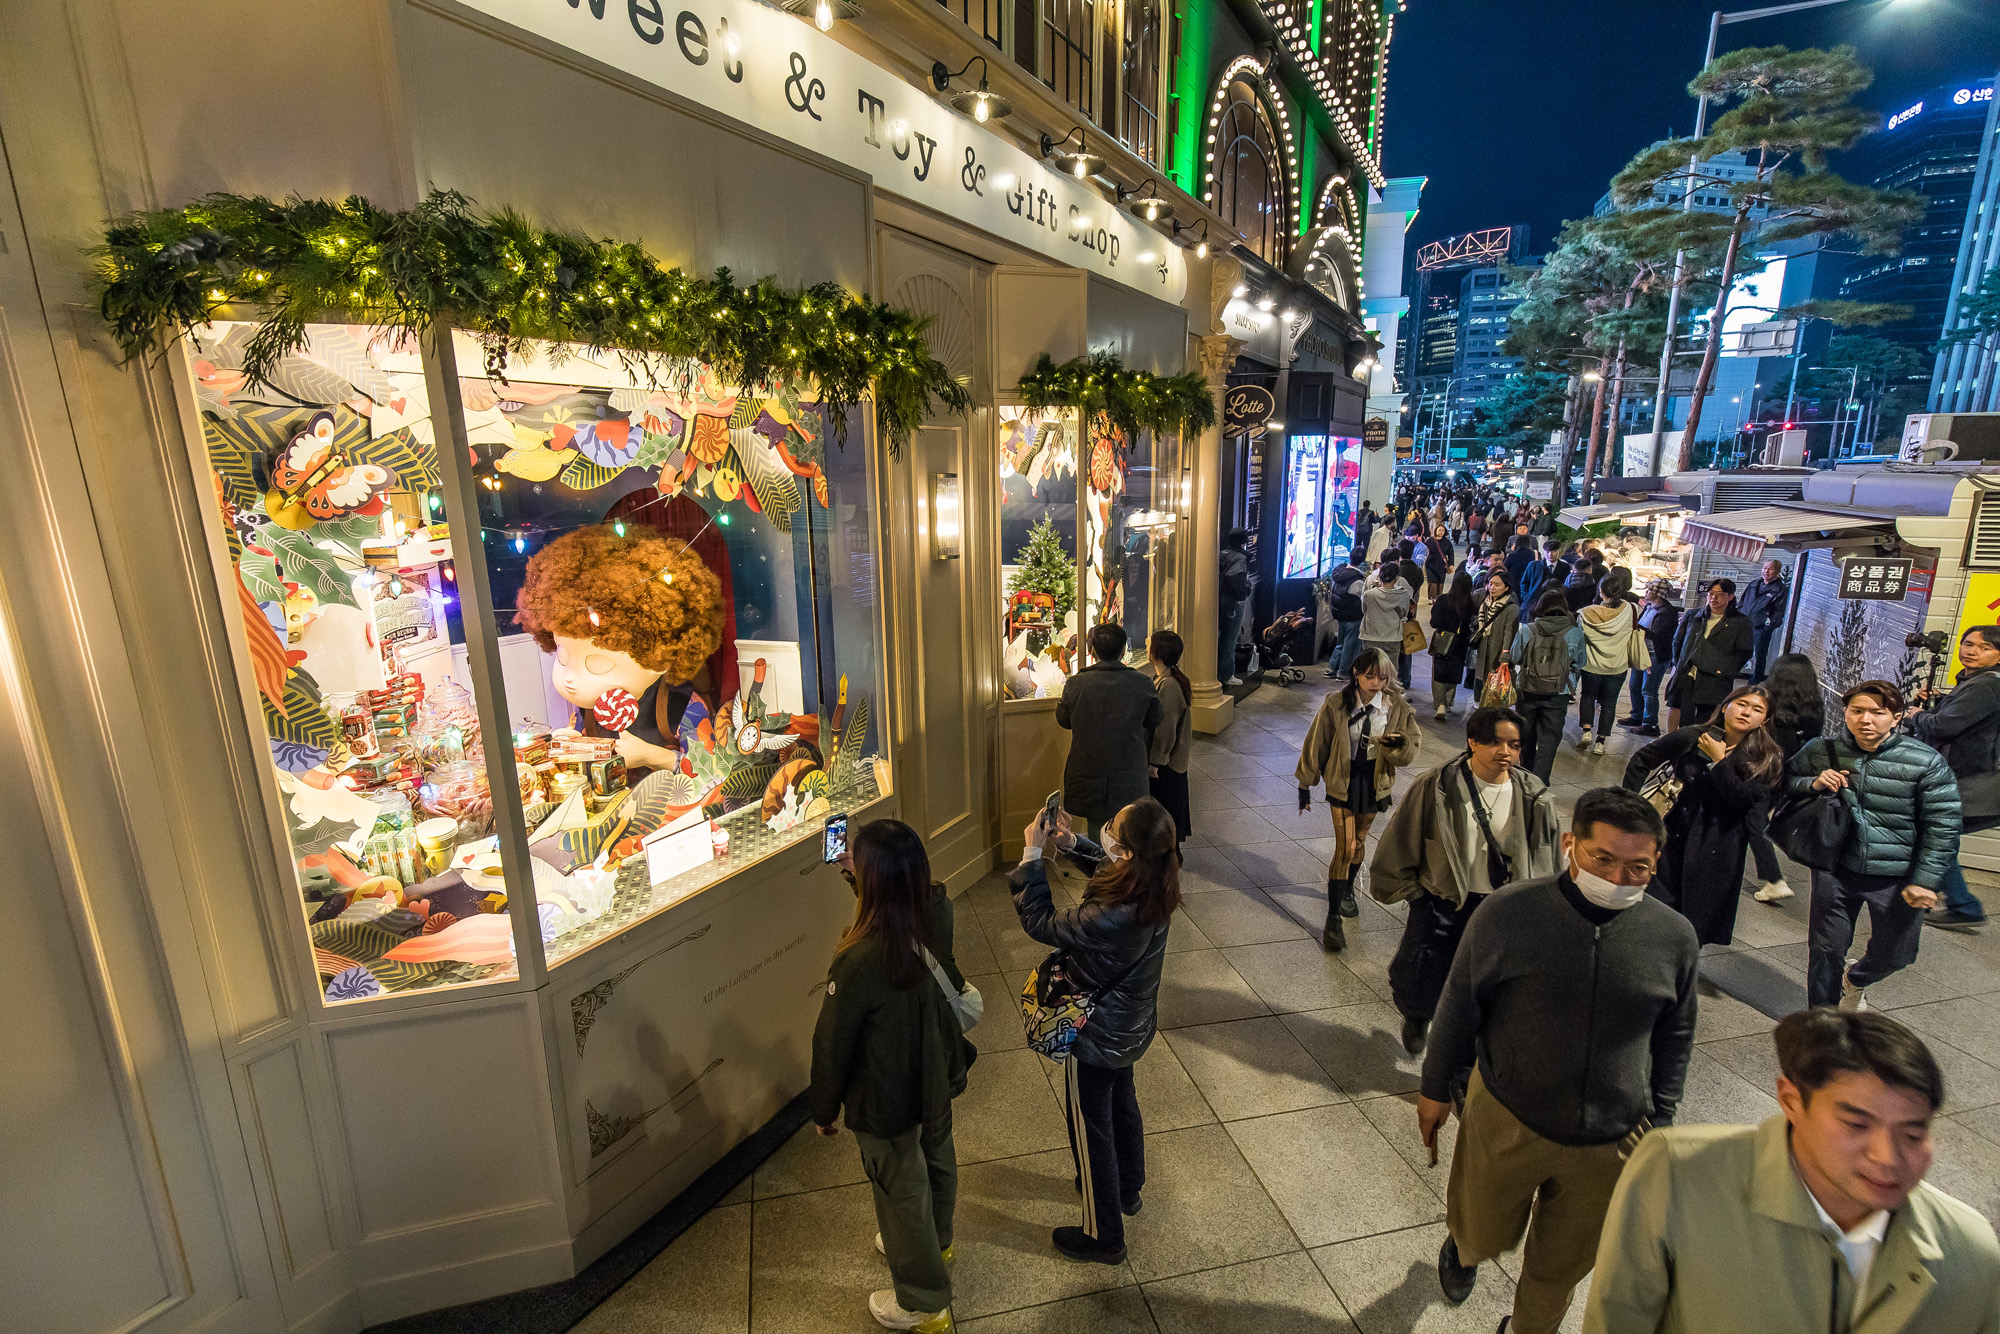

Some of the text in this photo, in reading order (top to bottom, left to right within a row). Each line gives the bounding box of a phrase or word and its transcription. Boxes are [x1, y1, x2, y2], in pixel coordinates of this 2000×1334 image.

[566, 0, 743, 83] eet
[785, 51, 825, 121] &
[858, 89, 937, 182] Toy
[961, 146, 986, 197] &
[1006, 172, 1058, 233] Gift
[1226, 393, 1265, 419] Lotte
[1623, 516, 1647, 524] COFFEE
[1849, 565, 1905, 579] 상품권
[1846, 579, 1901, 594] 商品券
[700, 933, 806, 1007] All the Lollipops in the world!
